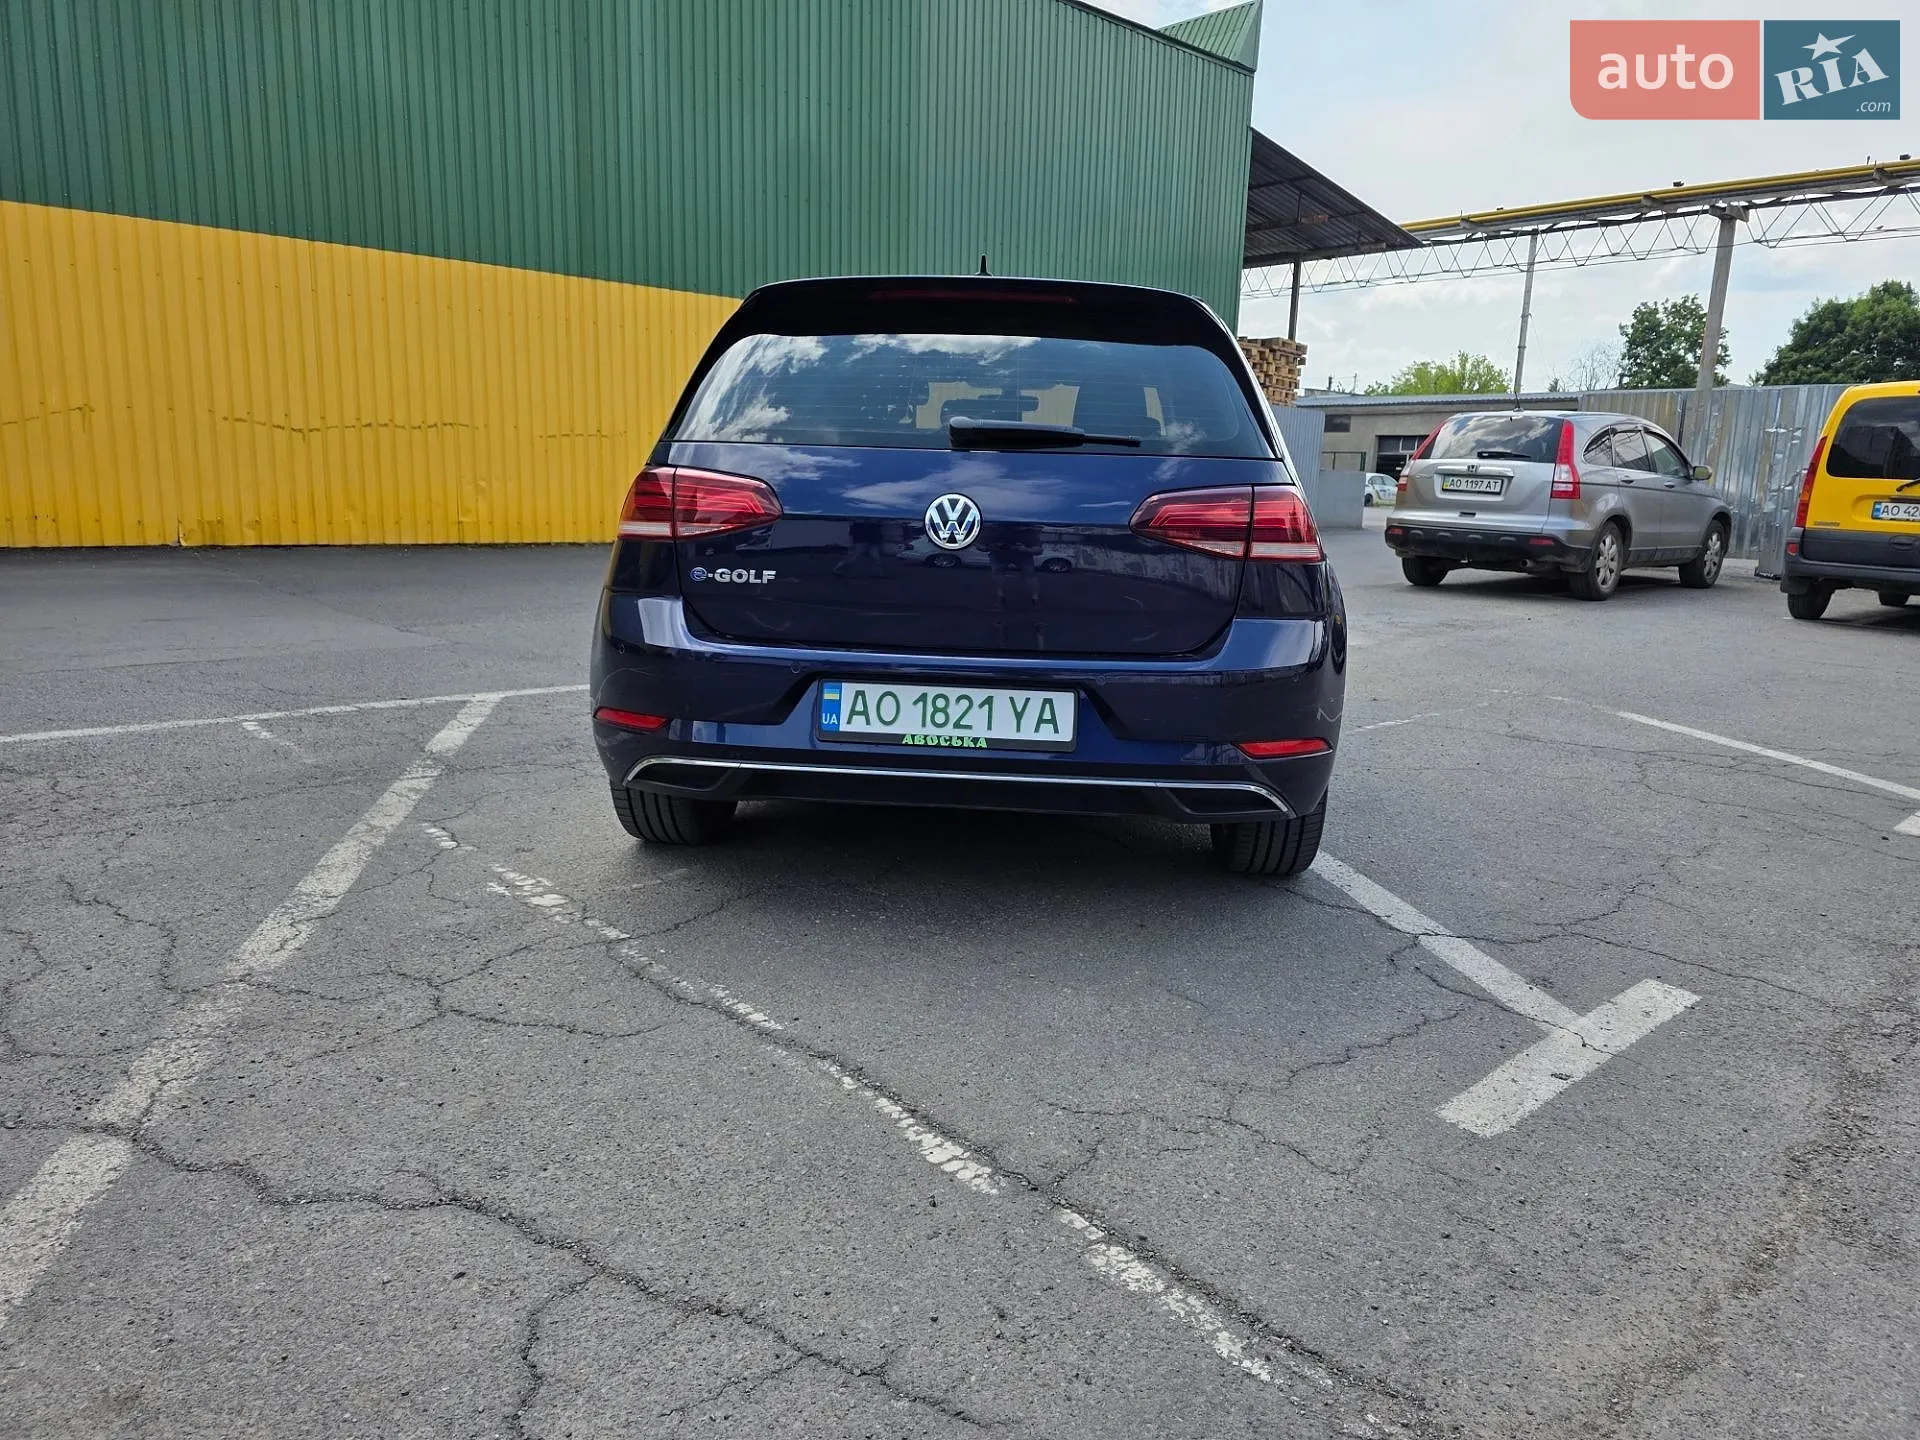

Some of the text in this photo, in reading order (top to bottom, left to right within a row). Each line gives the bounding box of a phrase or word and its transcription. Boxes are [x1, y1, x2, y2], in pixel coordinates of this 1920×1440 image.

[1449, 479, 1499, 491] AO 1197 AT
[1881, 505, 1920, 518] AO 42
[925, 493, 981, 549] VW
[822, 712, 838, 725] UA
[846, 690, 1060, 734] AO 1821 YA
